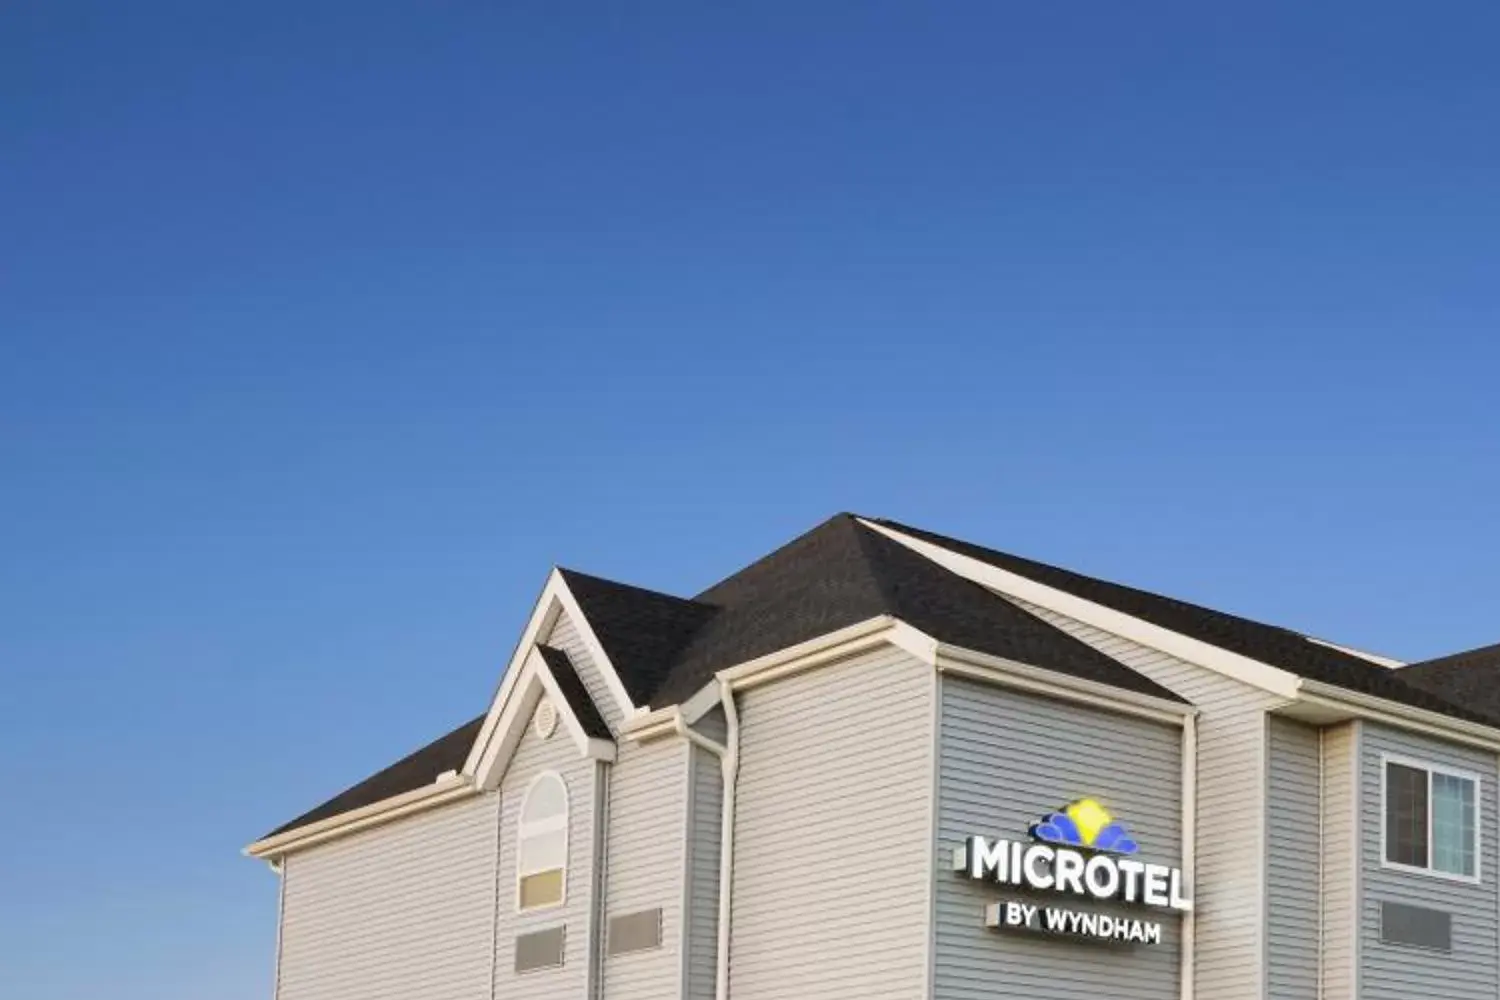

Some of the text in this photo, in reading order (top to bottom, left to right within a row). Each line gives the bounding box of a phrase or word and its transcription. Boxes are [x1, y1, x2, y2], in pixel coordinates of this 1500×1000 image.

[971, 835, 1194, 911] MICROTEL
[1006, 902, 1161, 944] BY WYNDHAM
